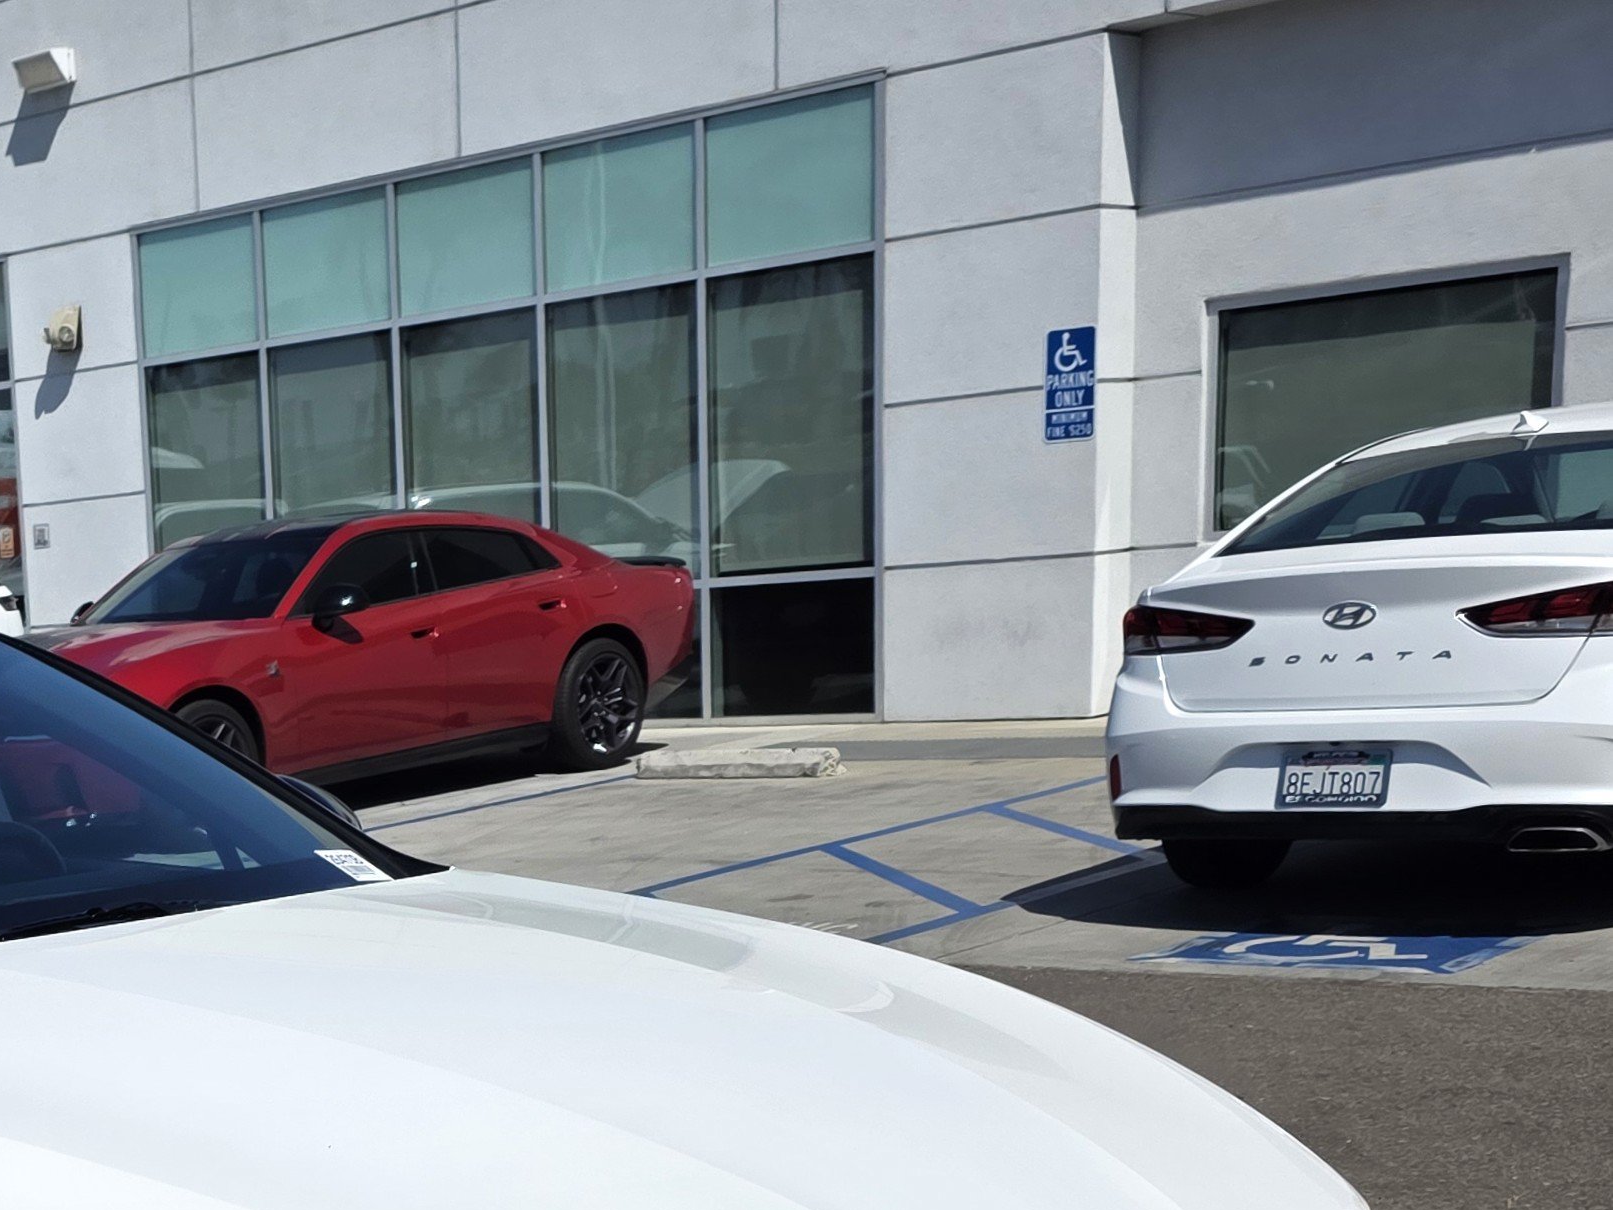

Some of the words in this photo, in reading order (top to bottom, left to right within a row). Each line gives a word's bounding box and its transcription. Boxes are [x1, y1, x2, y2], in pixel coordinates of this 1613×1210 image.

[1046, 370, 1094, 391] PARKING
[1055, 389, 1085, 407] ONLY
[1047, 425, 1065, 438] FINE
[1068, 423, 1092, 437] $250
[1248, 650, 1452, 668] SONATA
[1286, 771, 1381, 796] 8EJT807
